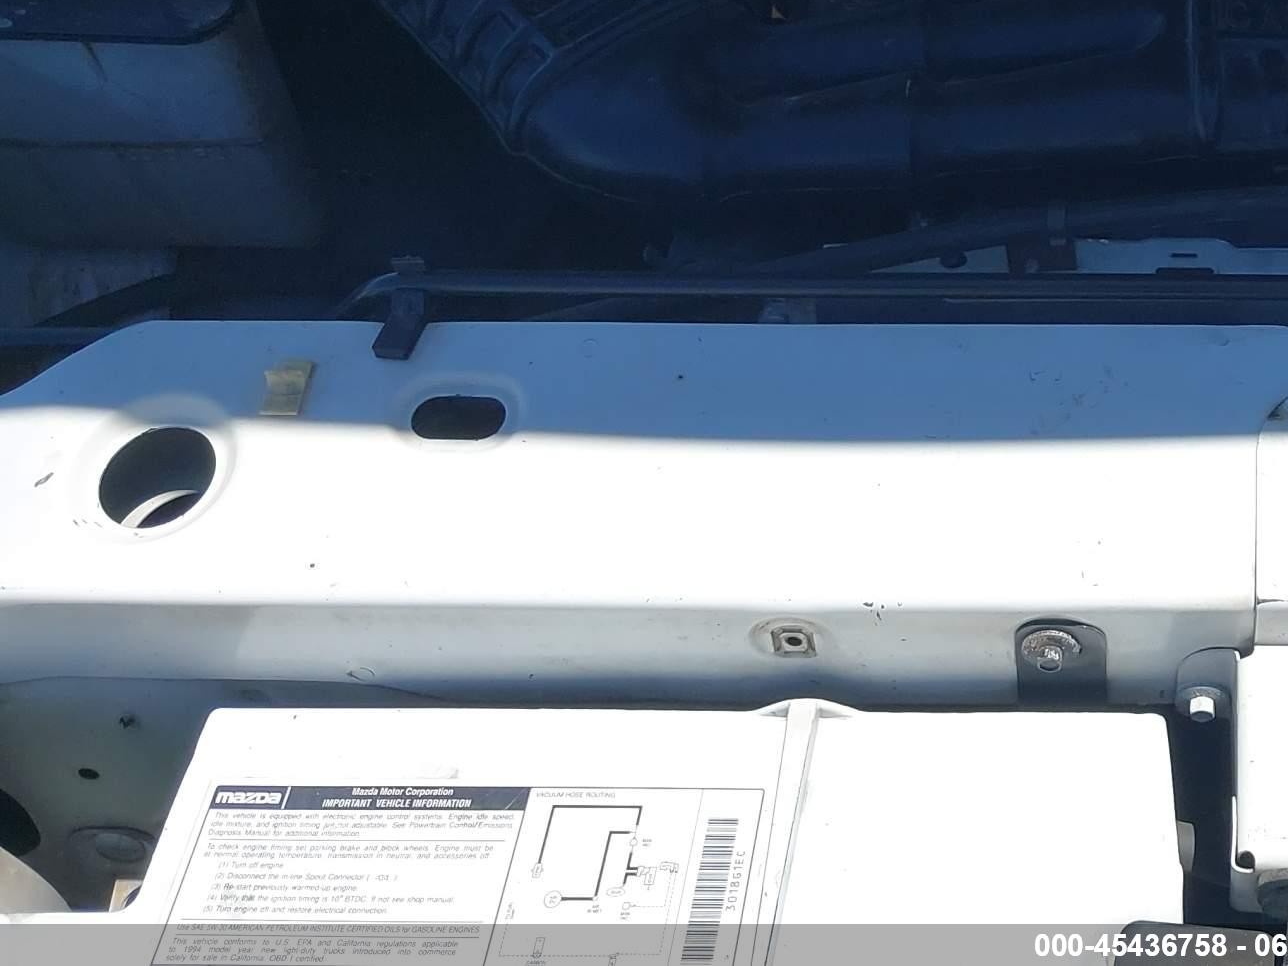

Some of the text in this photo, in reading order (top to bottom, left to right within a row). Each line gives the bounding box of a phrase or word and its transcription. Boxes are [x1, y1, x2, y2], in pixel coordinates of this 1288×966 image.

[352, 788, 453, 796] Mazda Motor Corporation
[215, 791, 282, 805] mazda
[321, 799, 472, 808] IMPORTANT VEHICLE INFORMATION
